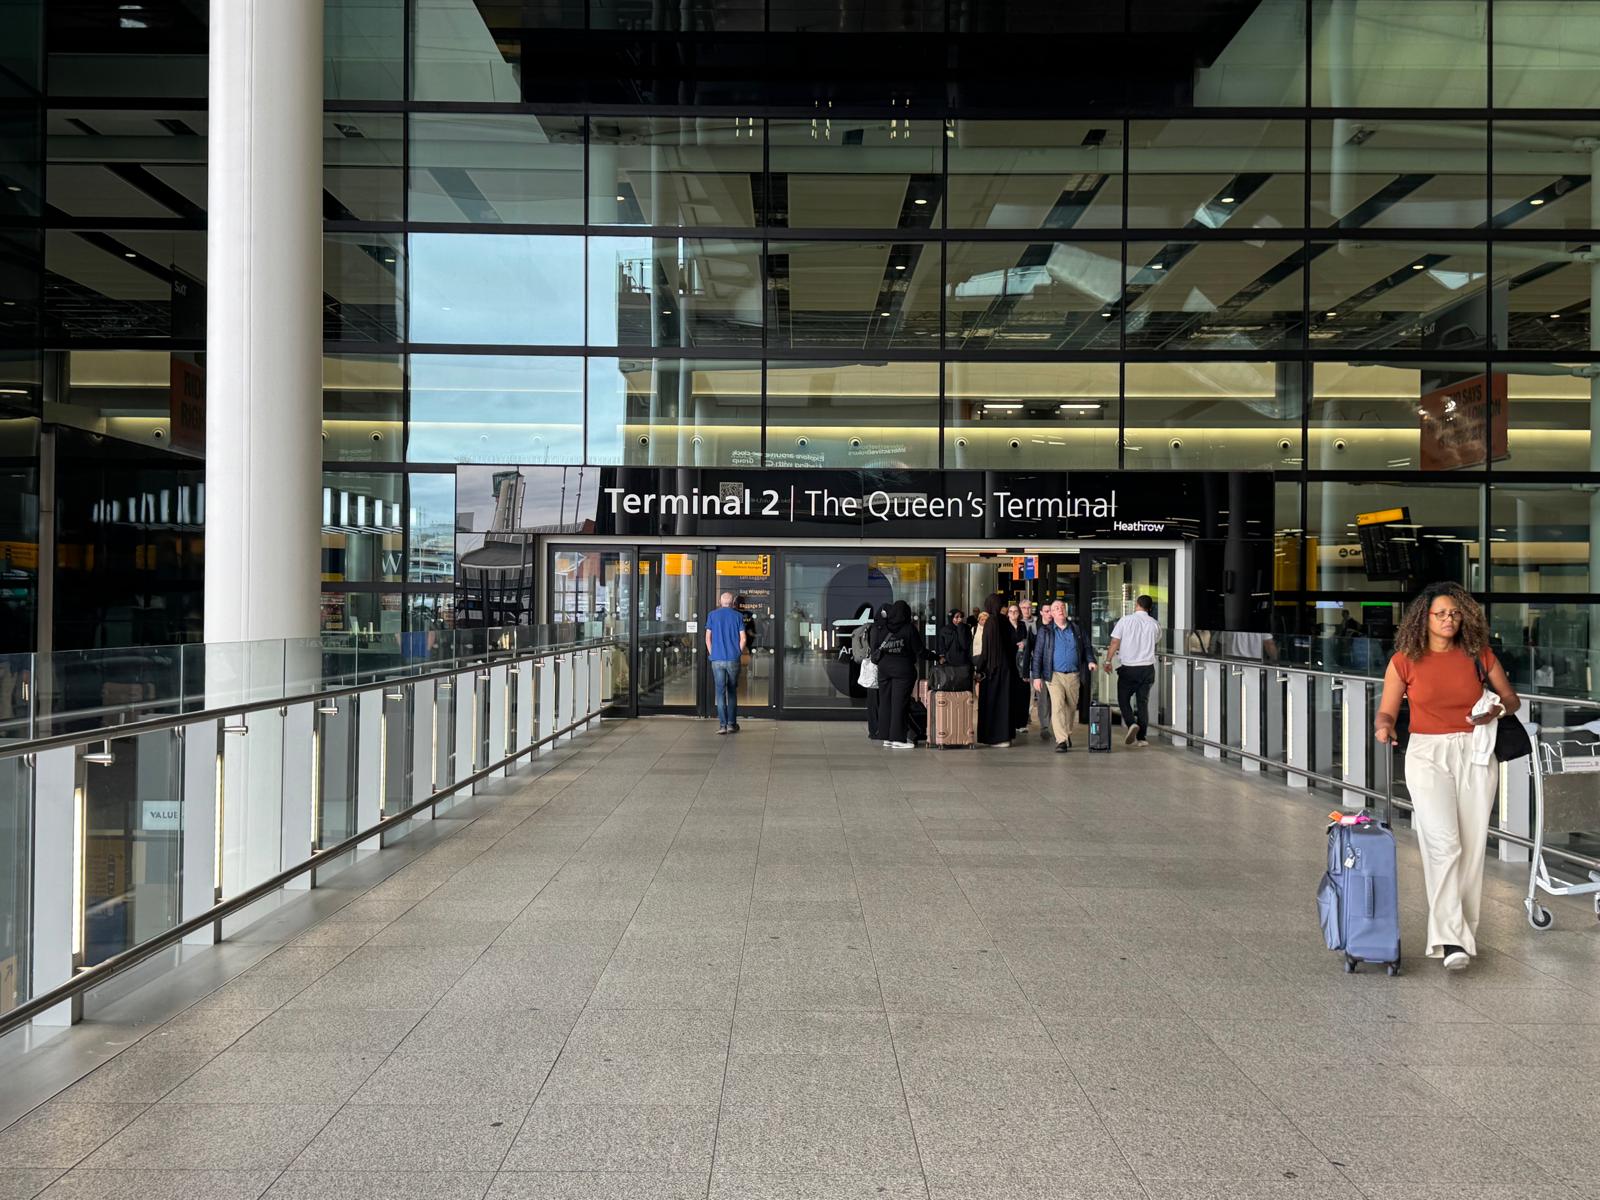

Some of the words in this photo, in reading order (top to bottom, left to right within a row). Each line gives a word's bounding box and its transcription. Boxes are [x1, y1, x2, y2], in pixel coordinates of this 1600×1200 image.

[604, 488, 750, 516] Terminal
[761, 488, 780, 516] 2
[804, 488, 859, 517] The
[868, 490, 984, 522] Queen's
[993, 490, 1117, 518] Terminal
[1113, 520, 1165, 533] Heathrow
